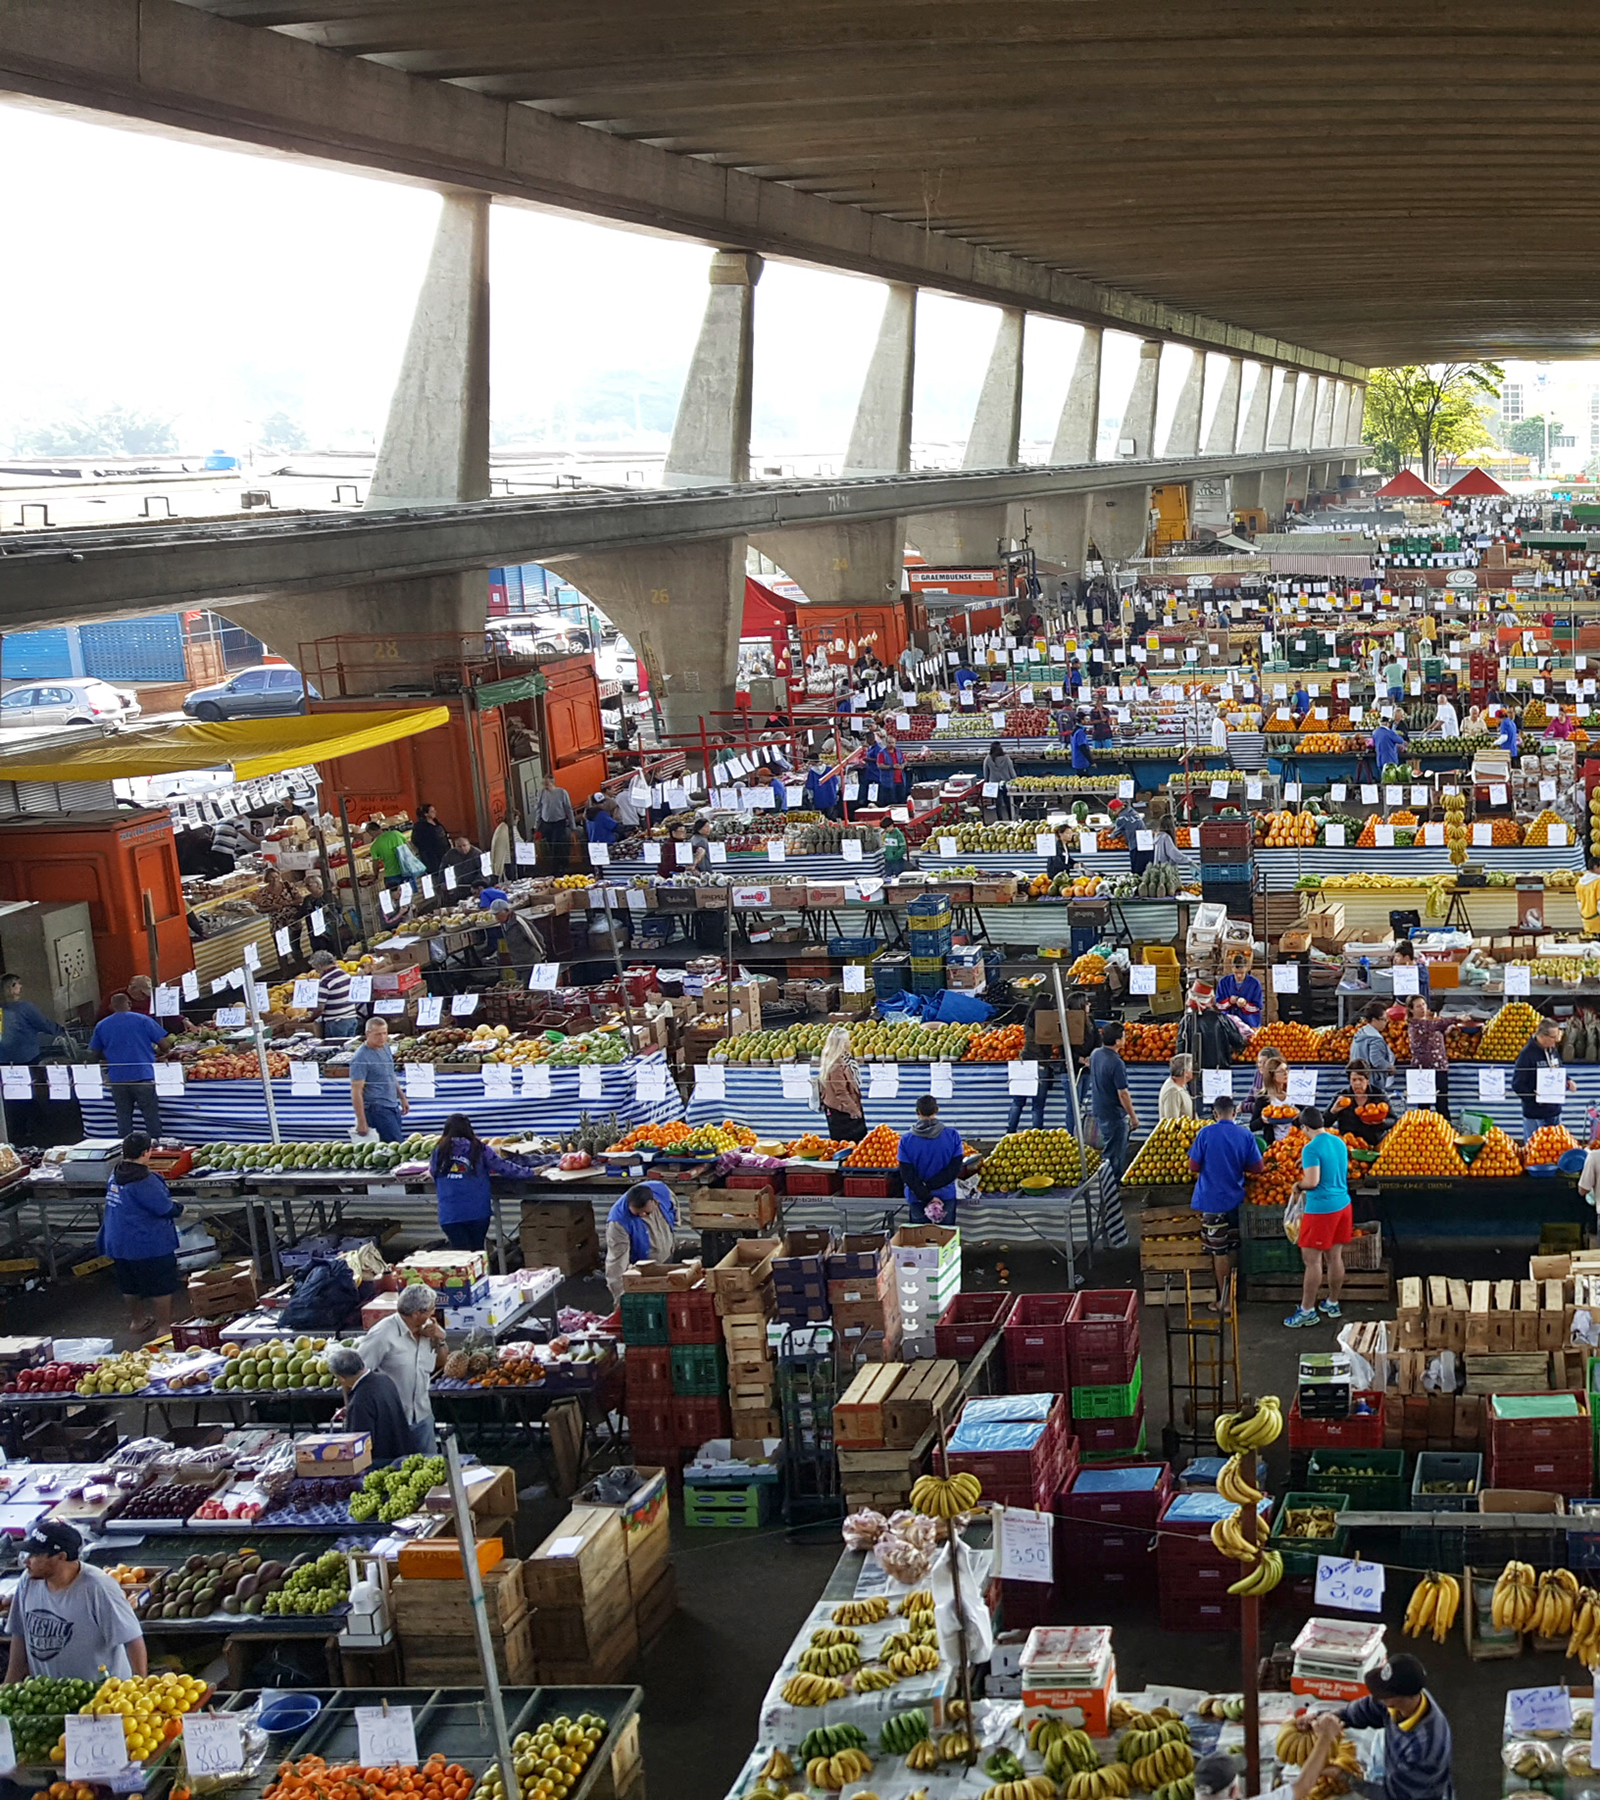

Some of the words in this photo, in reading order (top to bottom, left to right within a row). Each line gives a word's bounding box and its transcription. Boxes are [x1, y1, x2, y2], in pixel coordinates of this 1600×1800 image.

[833, 557, 848, 571] 24
[650, 589, 669, 603] 26
[374, 641, 399, 659] 28
